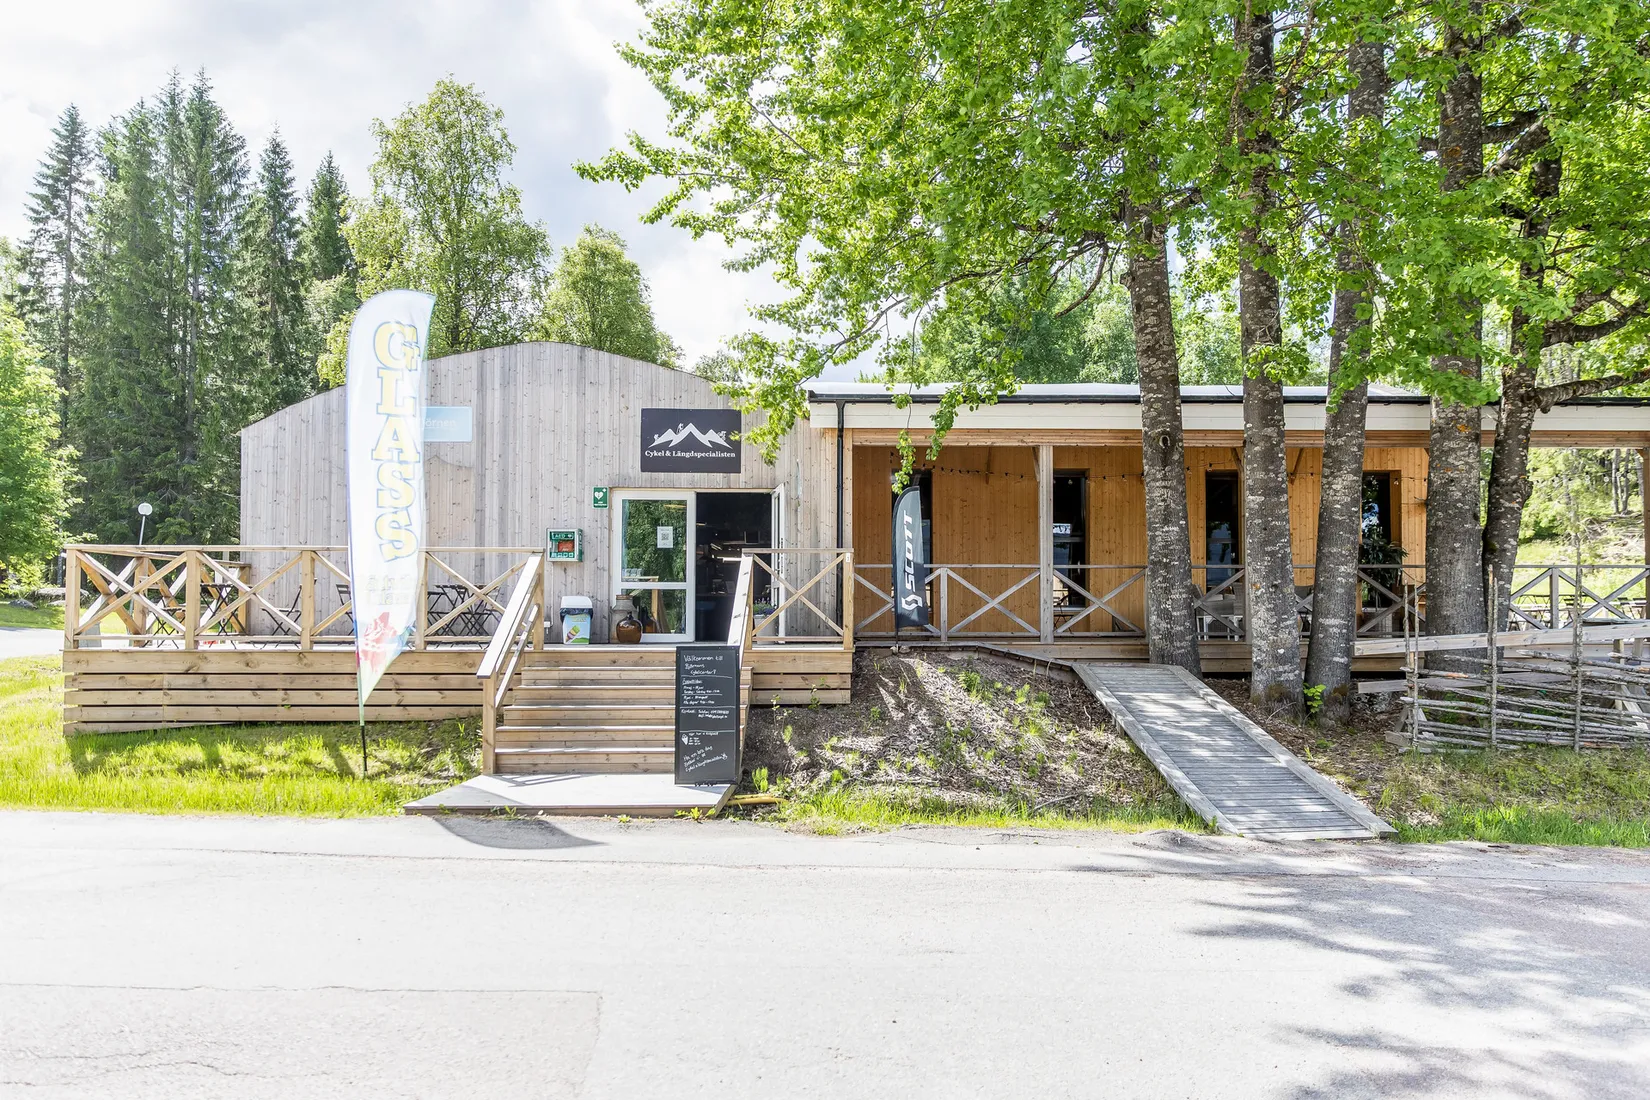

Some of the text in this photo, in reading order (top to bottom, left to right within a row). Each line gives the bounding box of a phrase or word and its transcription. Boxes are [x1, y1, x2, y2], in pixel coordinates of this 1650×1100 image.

[371, 320, 421, 563] GLASS
[645, 450, 665, 458] Cykel
[672, 450, 736, 458] Längdspecialisten
[903, 510, 916, 593] SCOTT
